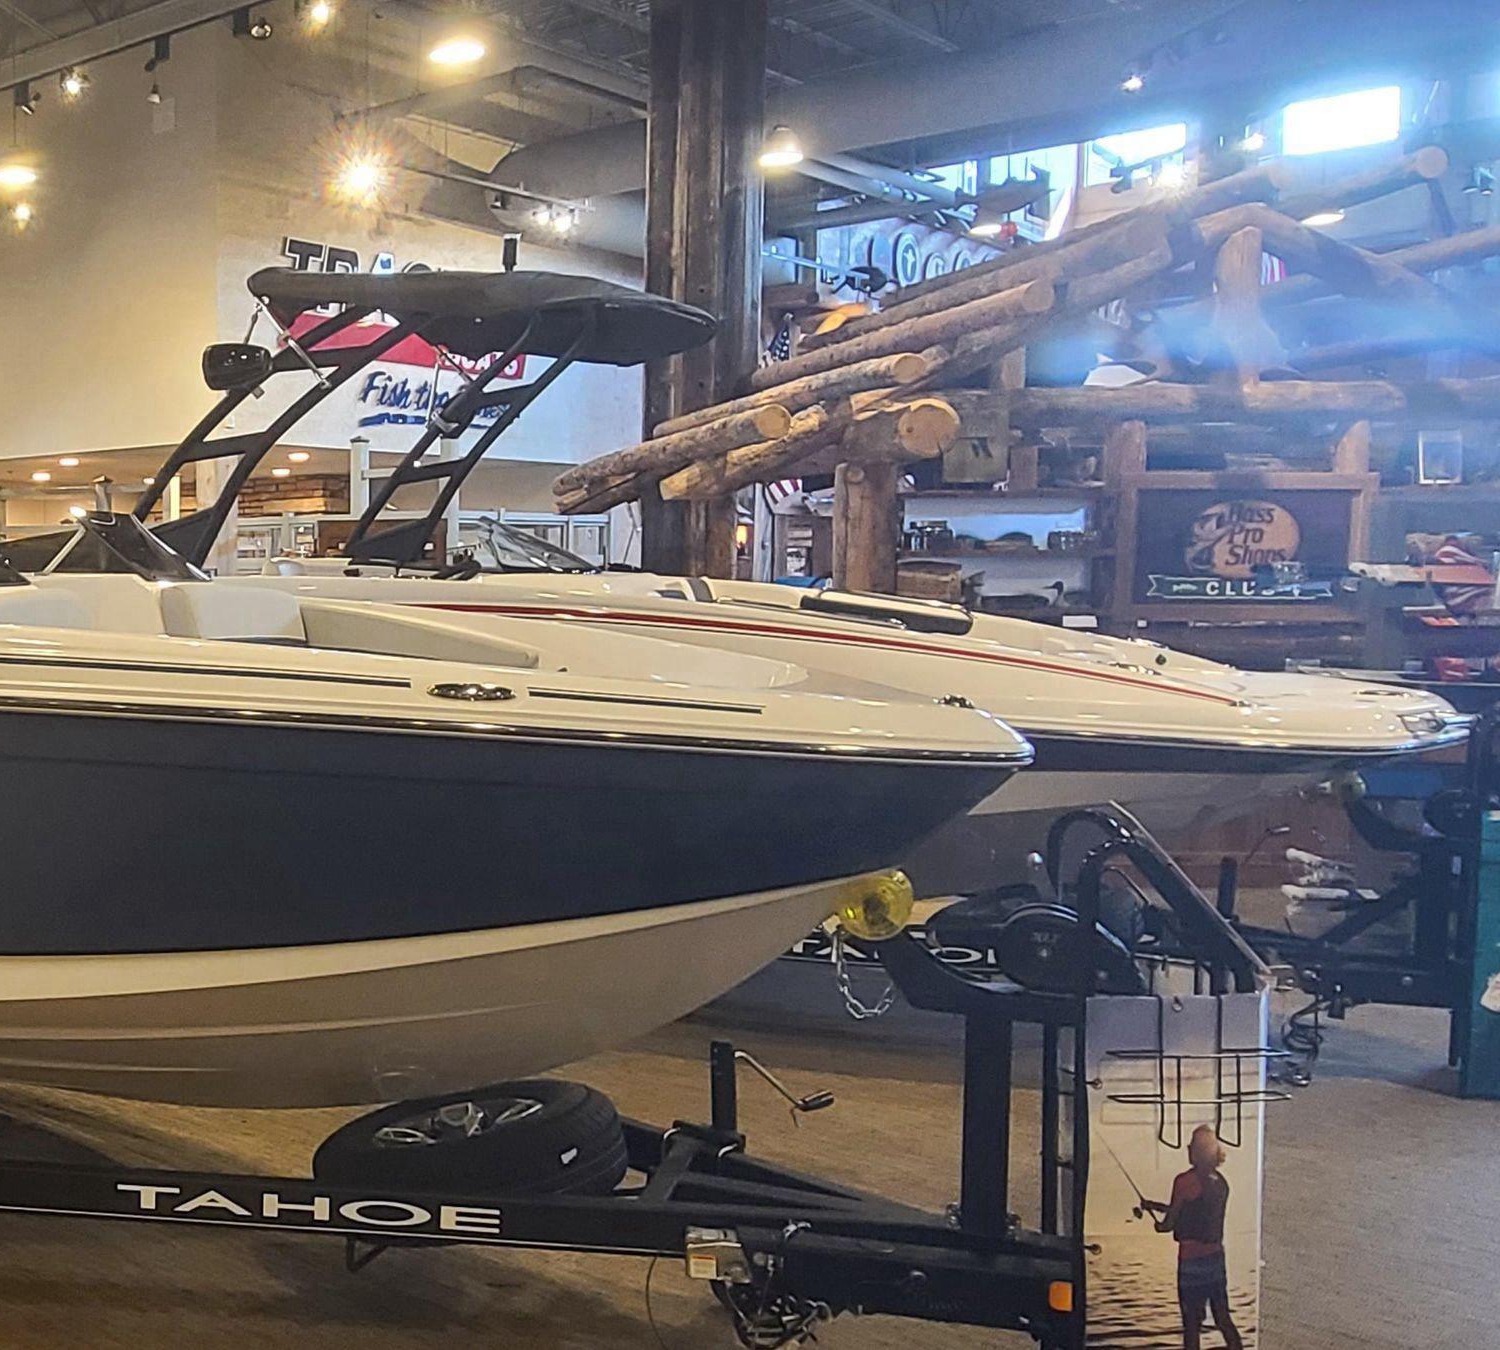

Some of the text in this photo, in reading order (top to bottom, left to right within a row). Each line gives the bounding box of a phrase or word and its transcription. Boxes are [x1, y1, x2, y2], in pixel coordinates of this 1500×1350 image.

[359, 371, 412, 410] Fish
[1227, 527, 1265, 545] Pro
[116, 1183, 501, 1234] TAHOE
